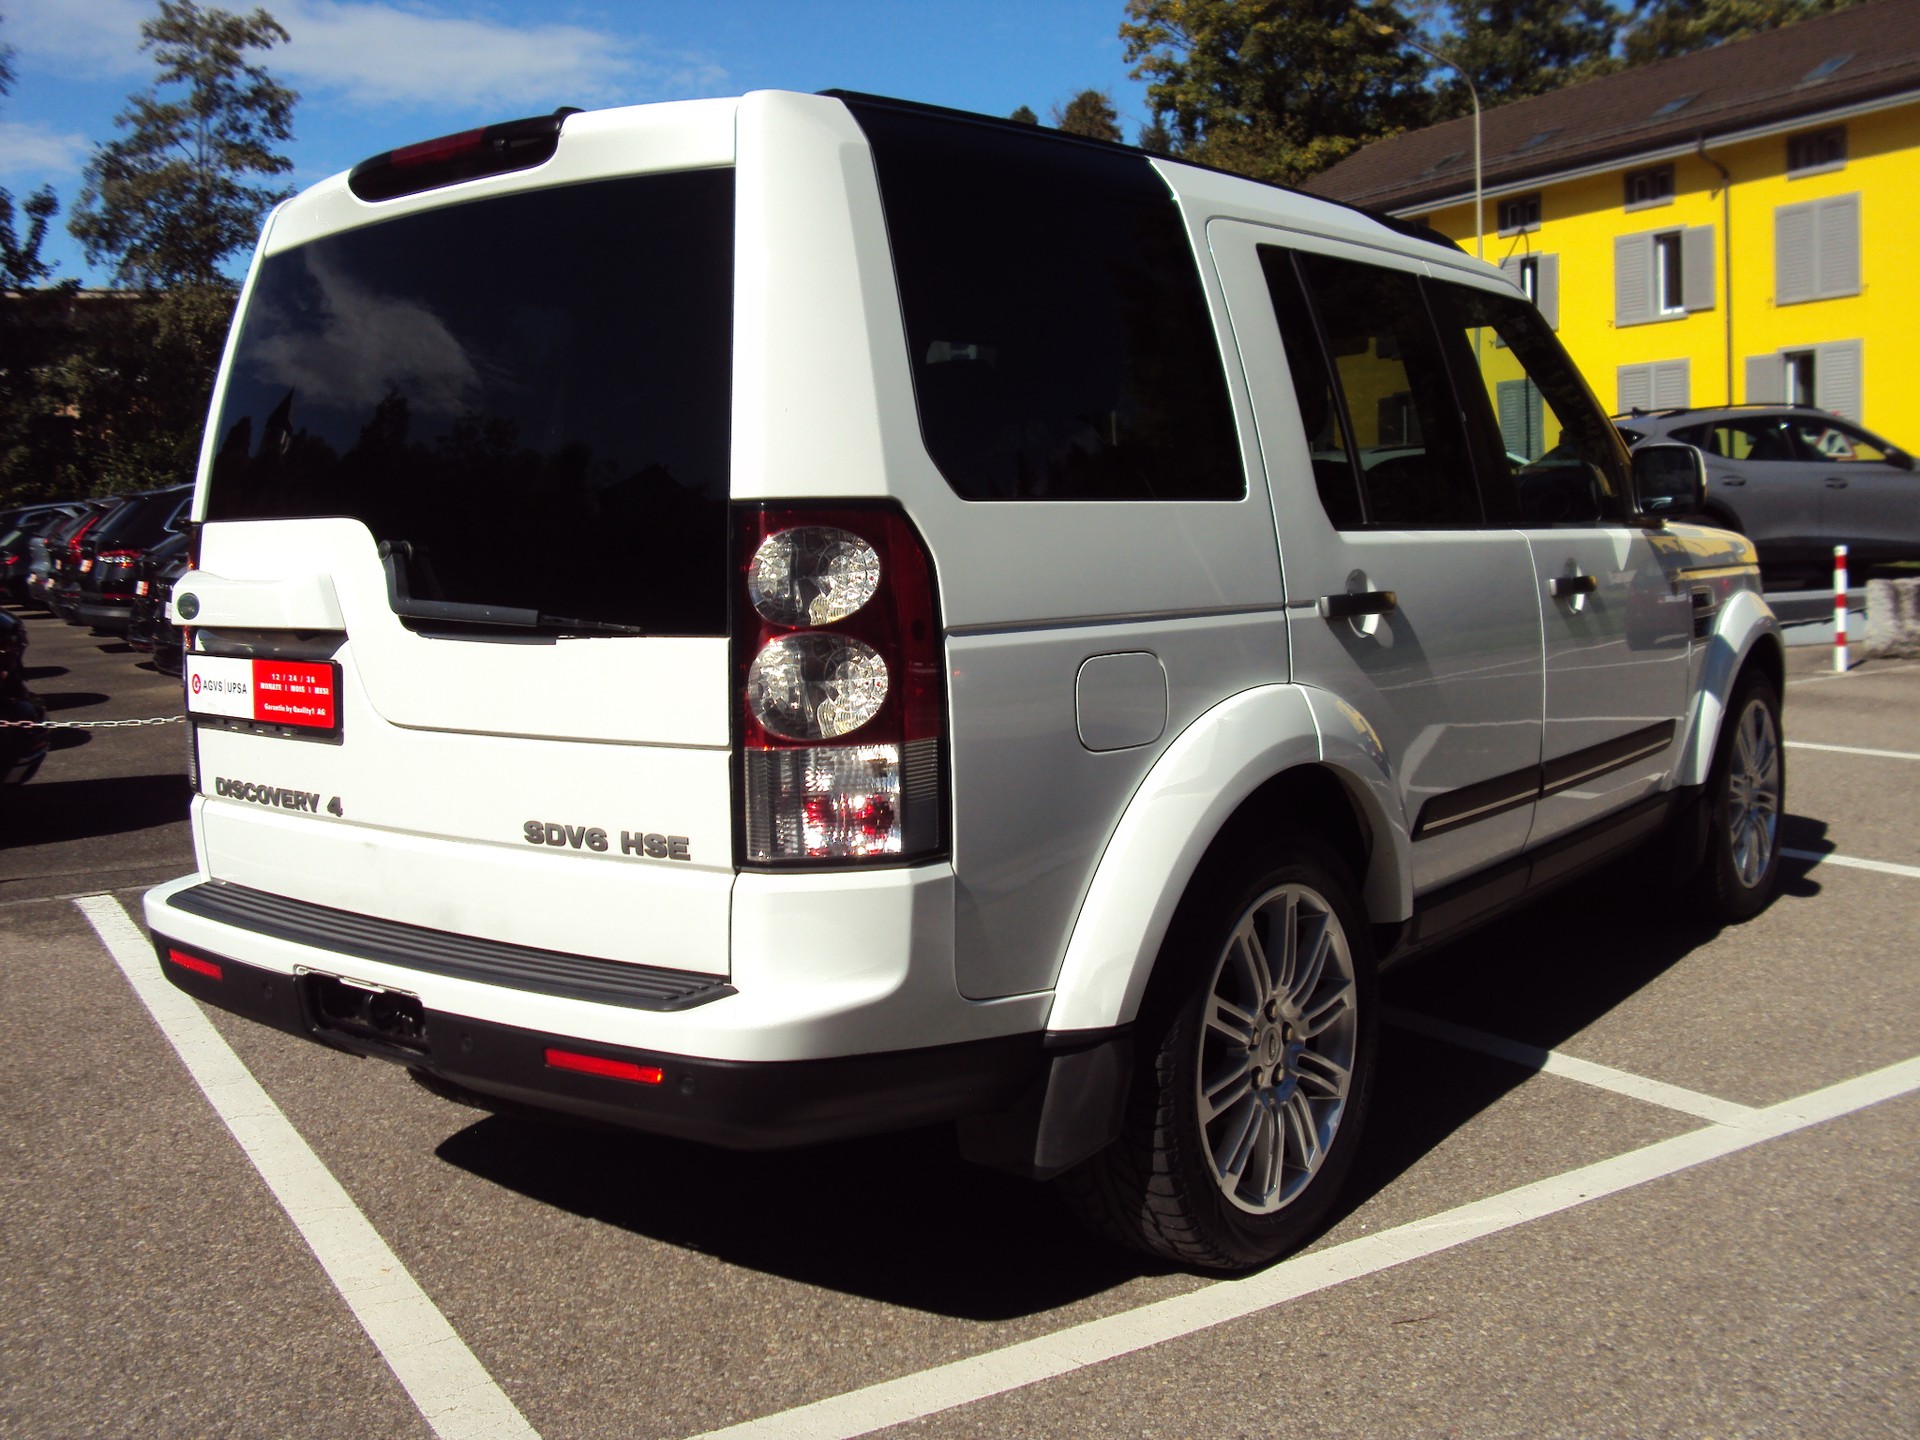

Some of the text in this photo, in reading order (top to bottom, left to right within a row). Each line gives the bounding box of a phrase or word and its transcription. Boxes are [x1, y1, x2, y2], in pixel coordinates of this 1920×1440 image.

[272, 673, 280, 681] 12
[203, 680, 223, 692] AGVS
[227, 683, 247, 694] UPSA
[264, 703, 285, 712] Garantie
[286, 705, 292, 714] by
[317, 708, 326, 716] AG
[216, 777, 344, 817] DISCOVERY 4
[524, 820, 691, 861] SDV6 HSE
